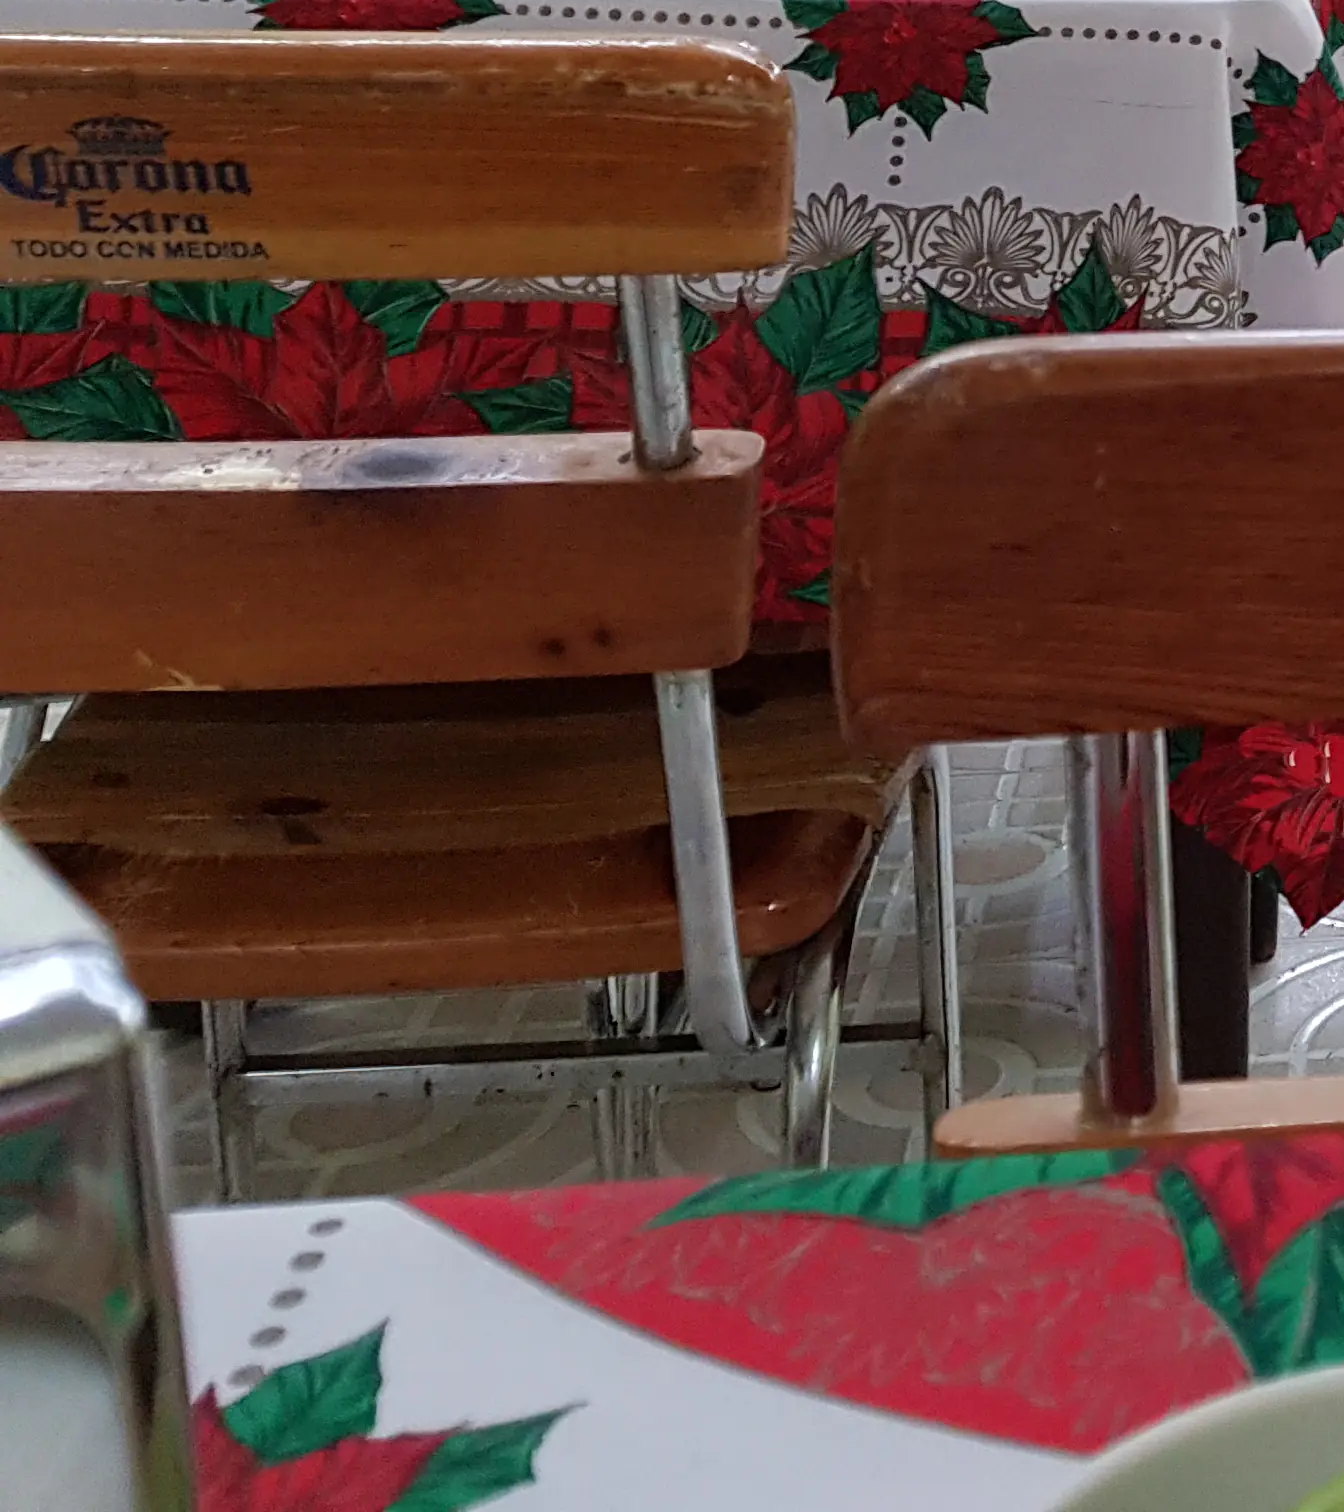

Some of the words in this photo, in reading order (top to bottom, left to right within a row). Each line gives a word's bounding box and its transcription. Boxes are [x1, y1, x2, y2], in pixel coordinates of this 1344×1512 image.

[0, 144, 253, 208] Corona
[75, 199, 210, 235] Extra
[10, 239, 89, 260] TODO
[97, 239, 156, 260] CON
[163, 240, 270, 261] MEDIDA
